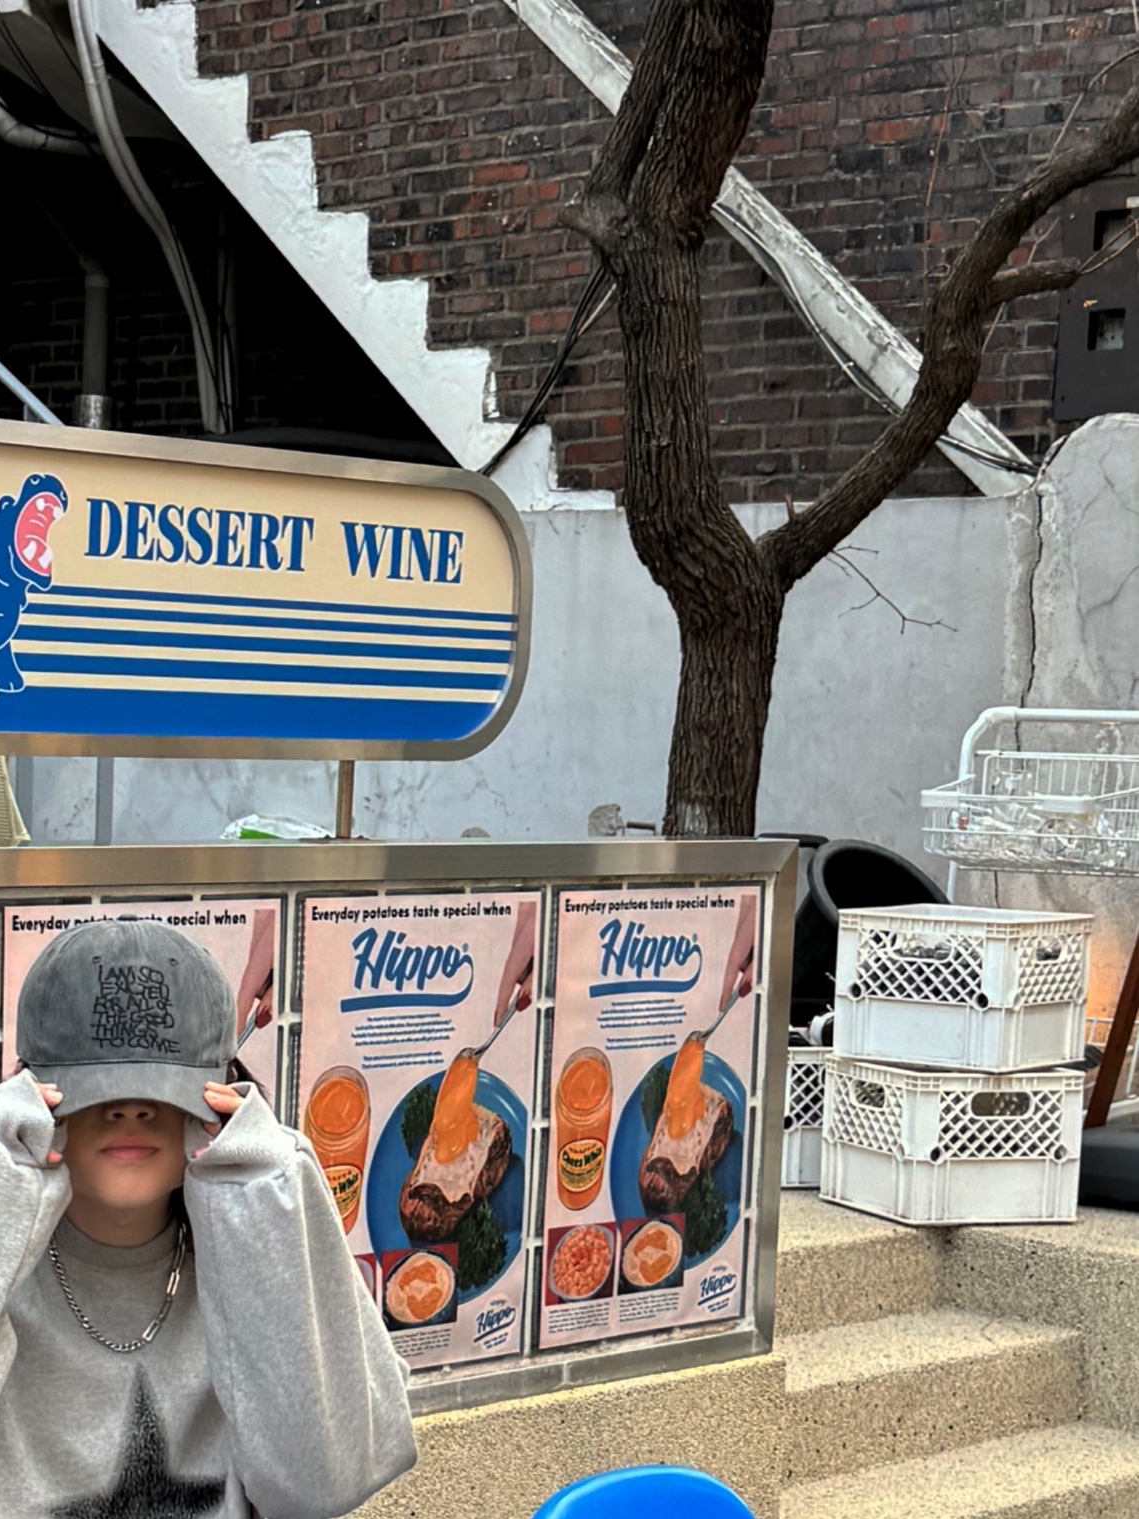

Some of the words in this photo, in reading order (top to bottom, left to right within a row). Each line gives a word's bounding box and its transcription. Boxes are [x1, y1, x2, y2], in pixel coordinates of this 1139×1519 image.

[84, 498, 314, 572] DESSERT
[340, 520, 464, 584] WINE
[311, 906, 360, 923] Everyday
[362, 906, 409, 922] potatoes
[413, 905, 440, 918] taste
[443, 904, 480, 919] special
[483, 902, 511, 916] when
[565, 899, 606, 915] Everyday
[608, 899, 648, 914] potatoes
[650, 898, 673, 910] taste
[676, 897, 708, 911] special
[710, 895, 735, 908] when
[214, 909, 246, 925] when
[599, 917, 700, 979] Hippo
[351, 927, 471, 991] Hippo
[98, 964, 103, 982] I
[105, 966, 136, 983] AM
[138, 966, 164, 983] SO
[100, 981, 170, 1000] EXCITED
[91, 1023, 158, 1039] THINGS
[127, 1035, 180, 1053] COME
